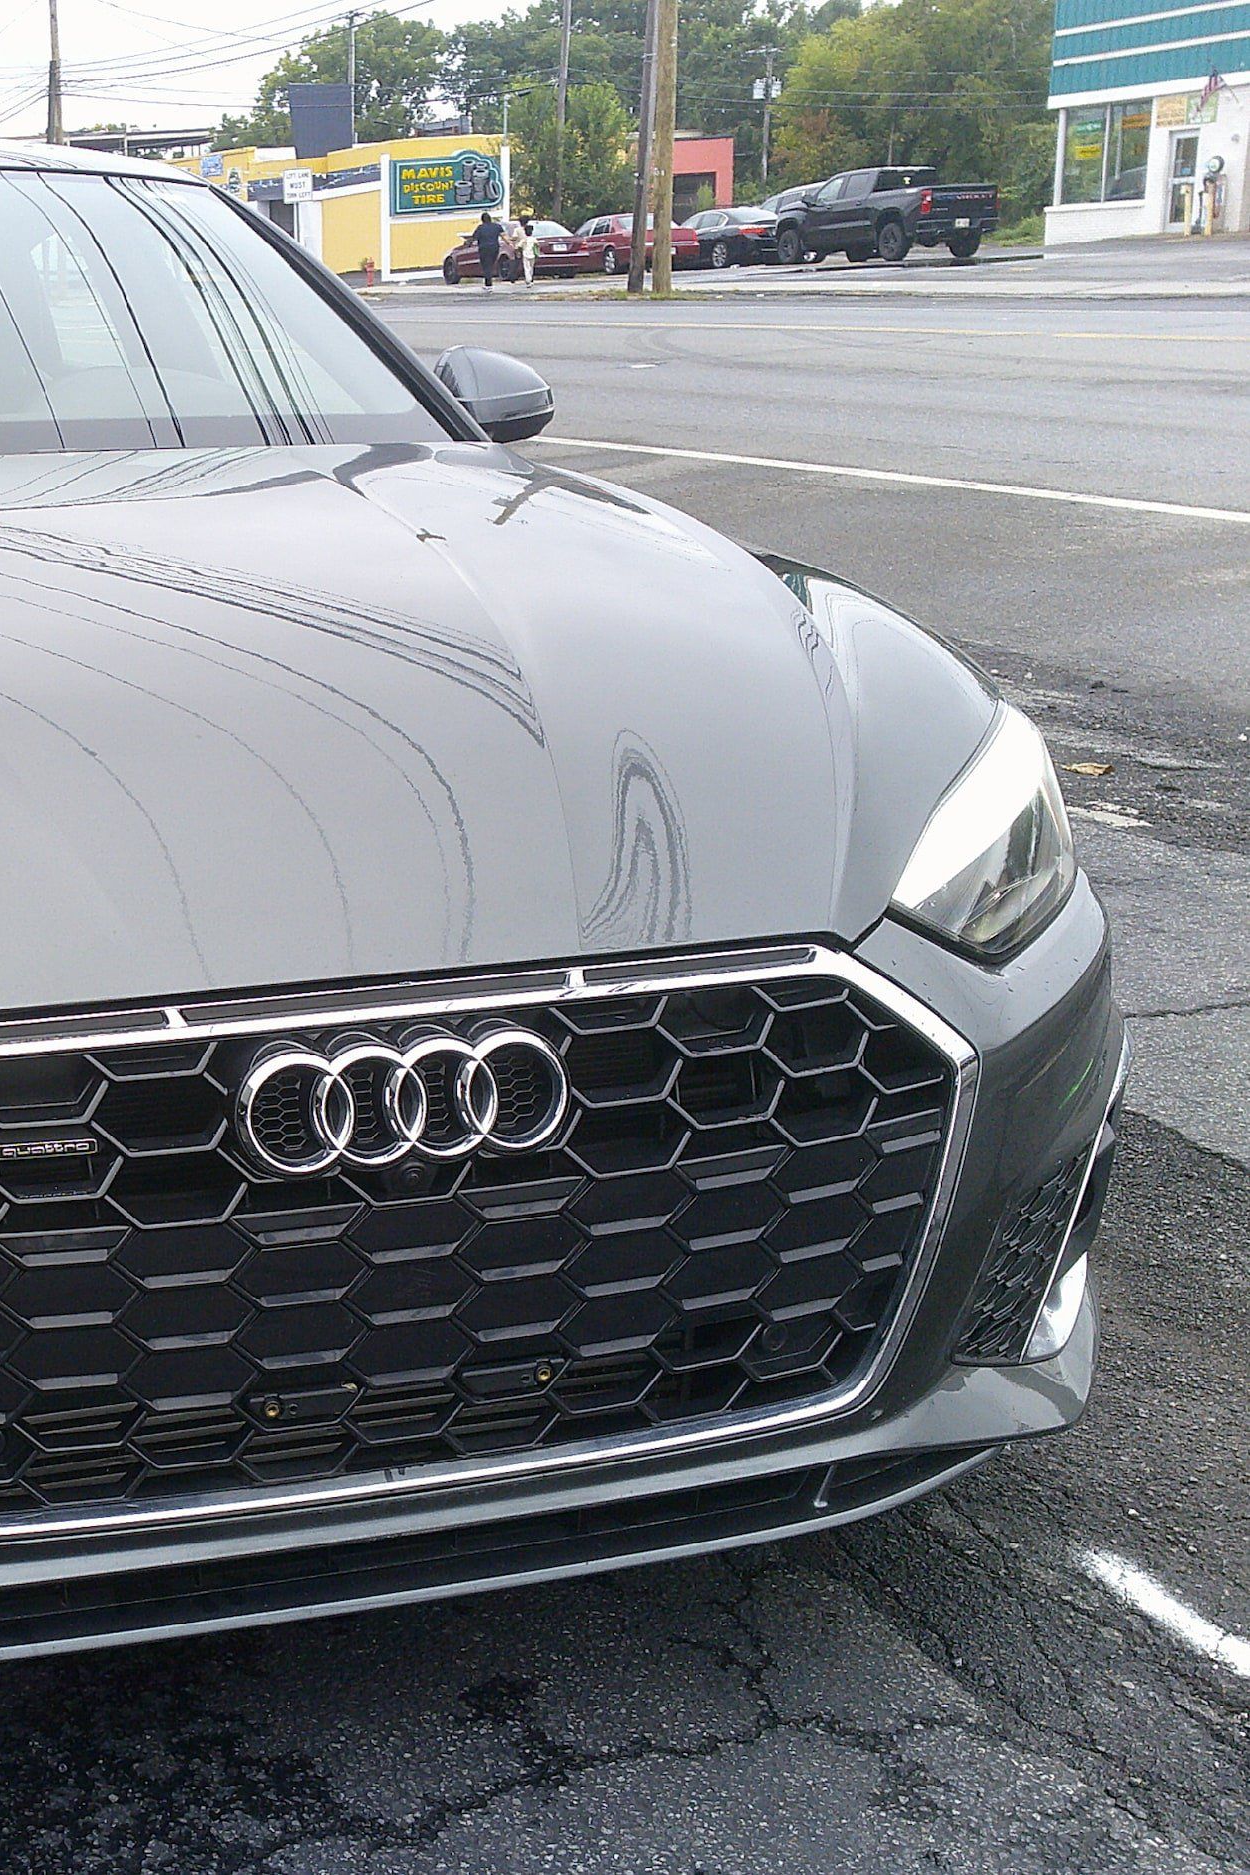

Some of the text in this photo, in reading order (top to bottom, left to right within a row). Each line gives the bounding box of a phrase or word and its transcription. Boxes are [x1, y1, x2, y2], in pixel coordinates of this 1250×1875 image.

[401, 166, 453, 179] MAVIS
[403, 180, 454, 193] DISCOUNT
[412, 194, 445, 205] TIRE
[2, 1142, 90, 1158] quattro
